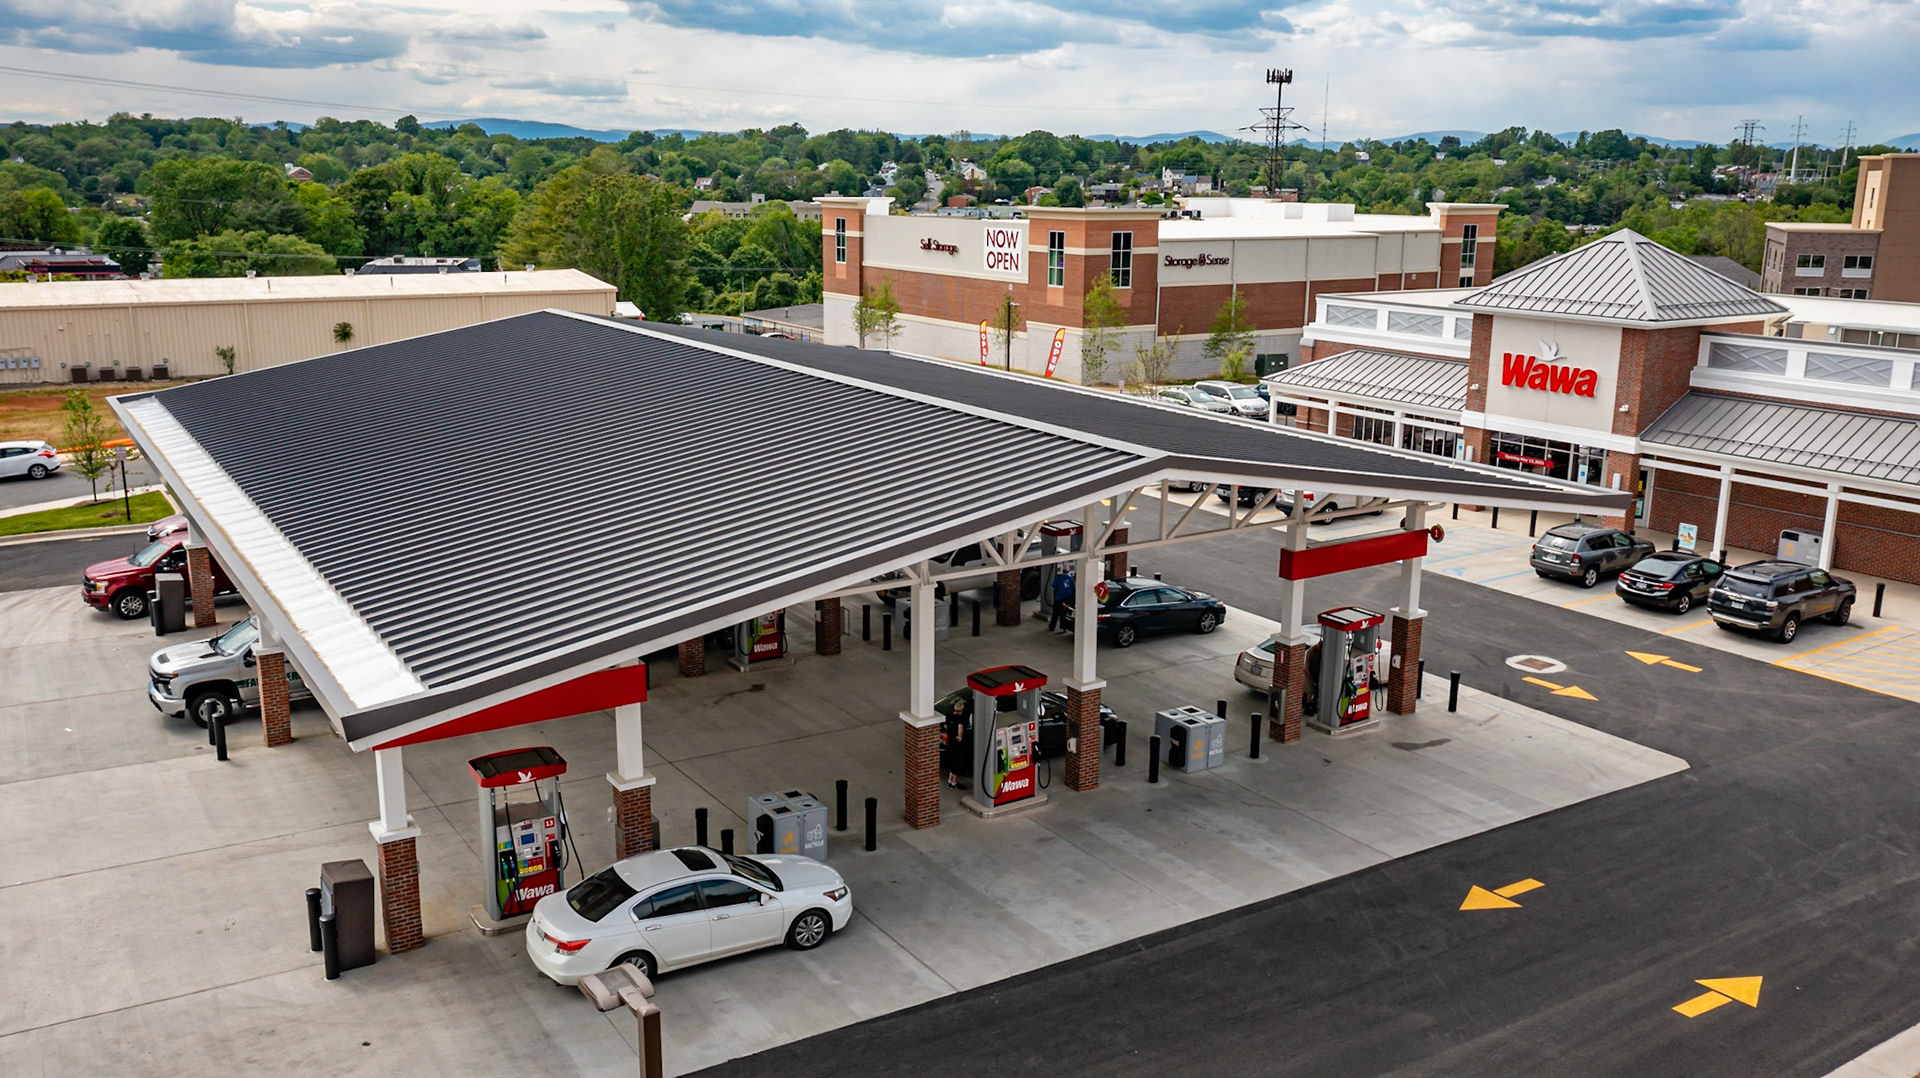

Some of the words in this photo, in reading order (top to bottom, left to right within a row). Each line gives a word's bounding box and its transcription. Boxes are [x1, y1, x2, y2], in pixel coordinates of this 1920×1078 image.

[933, 239, 958, 255] Storage
[987, 229, 1019, 249] NOW
[986, 251, 1019, 272] OPEN
[1164, 255, 1198, 269] Storage
[1206, 253, 1230, 266] Sense
[1048, 340, 1062, 372] OPEN
[1502, 353, 1598, 398] Wawa
[1434, 529, 1439, 537] 1
[1100, 587, 1104, 596] 7
[1001, 778, 1030, 793] Wawa
[545, 819, 554, 828] 13
[804, 840, 824, 849] RECYCLE
[515, 883, 555, 902] Wawa
